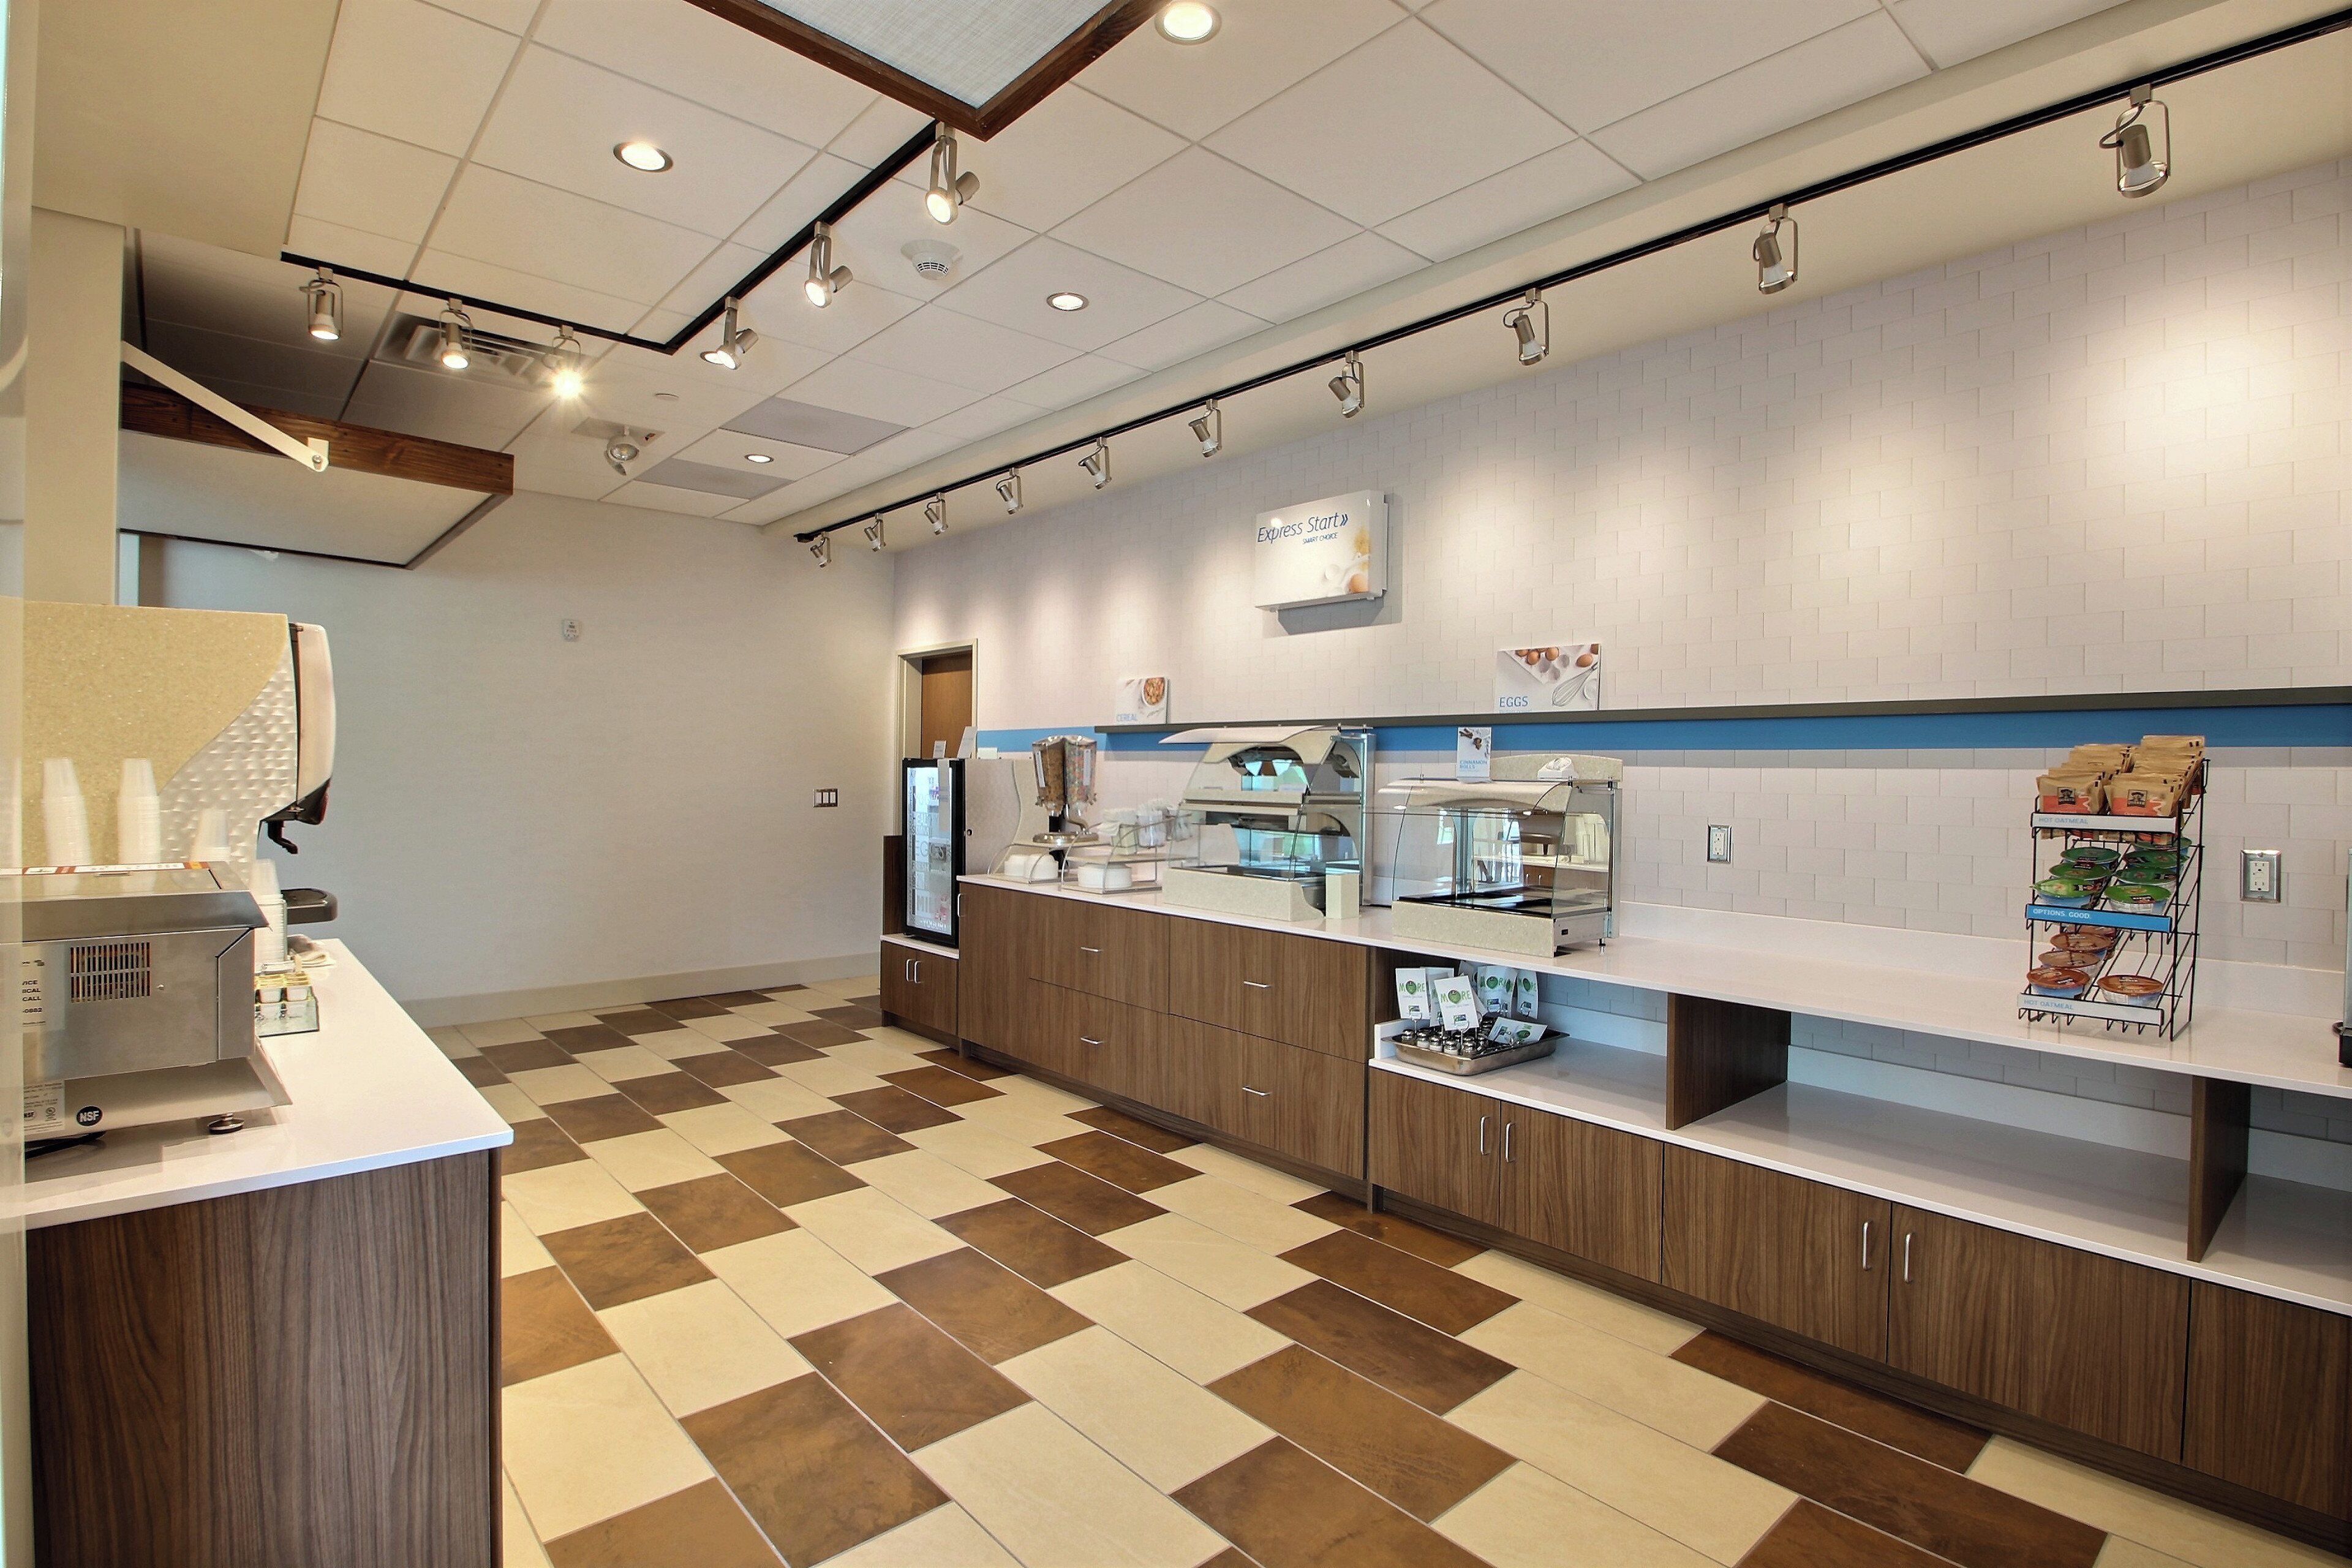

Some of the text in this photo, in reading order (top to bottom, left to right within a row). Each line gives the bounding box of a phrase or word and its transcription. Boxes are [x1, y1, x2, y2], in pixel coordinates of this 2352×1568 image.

[1257, 512, 1339, 544] Express Start
[1319, 532, 1338, 541] CHOICE
[1499, 696, 1529, 707] EGGS
[1398, 980, 1426, 995] MORE
[1440, 989, 1472, 1004] MORE
[2040, 1001, 2073, 1010] OATMEAL
[80, 1110, 99, 1123] NSF
